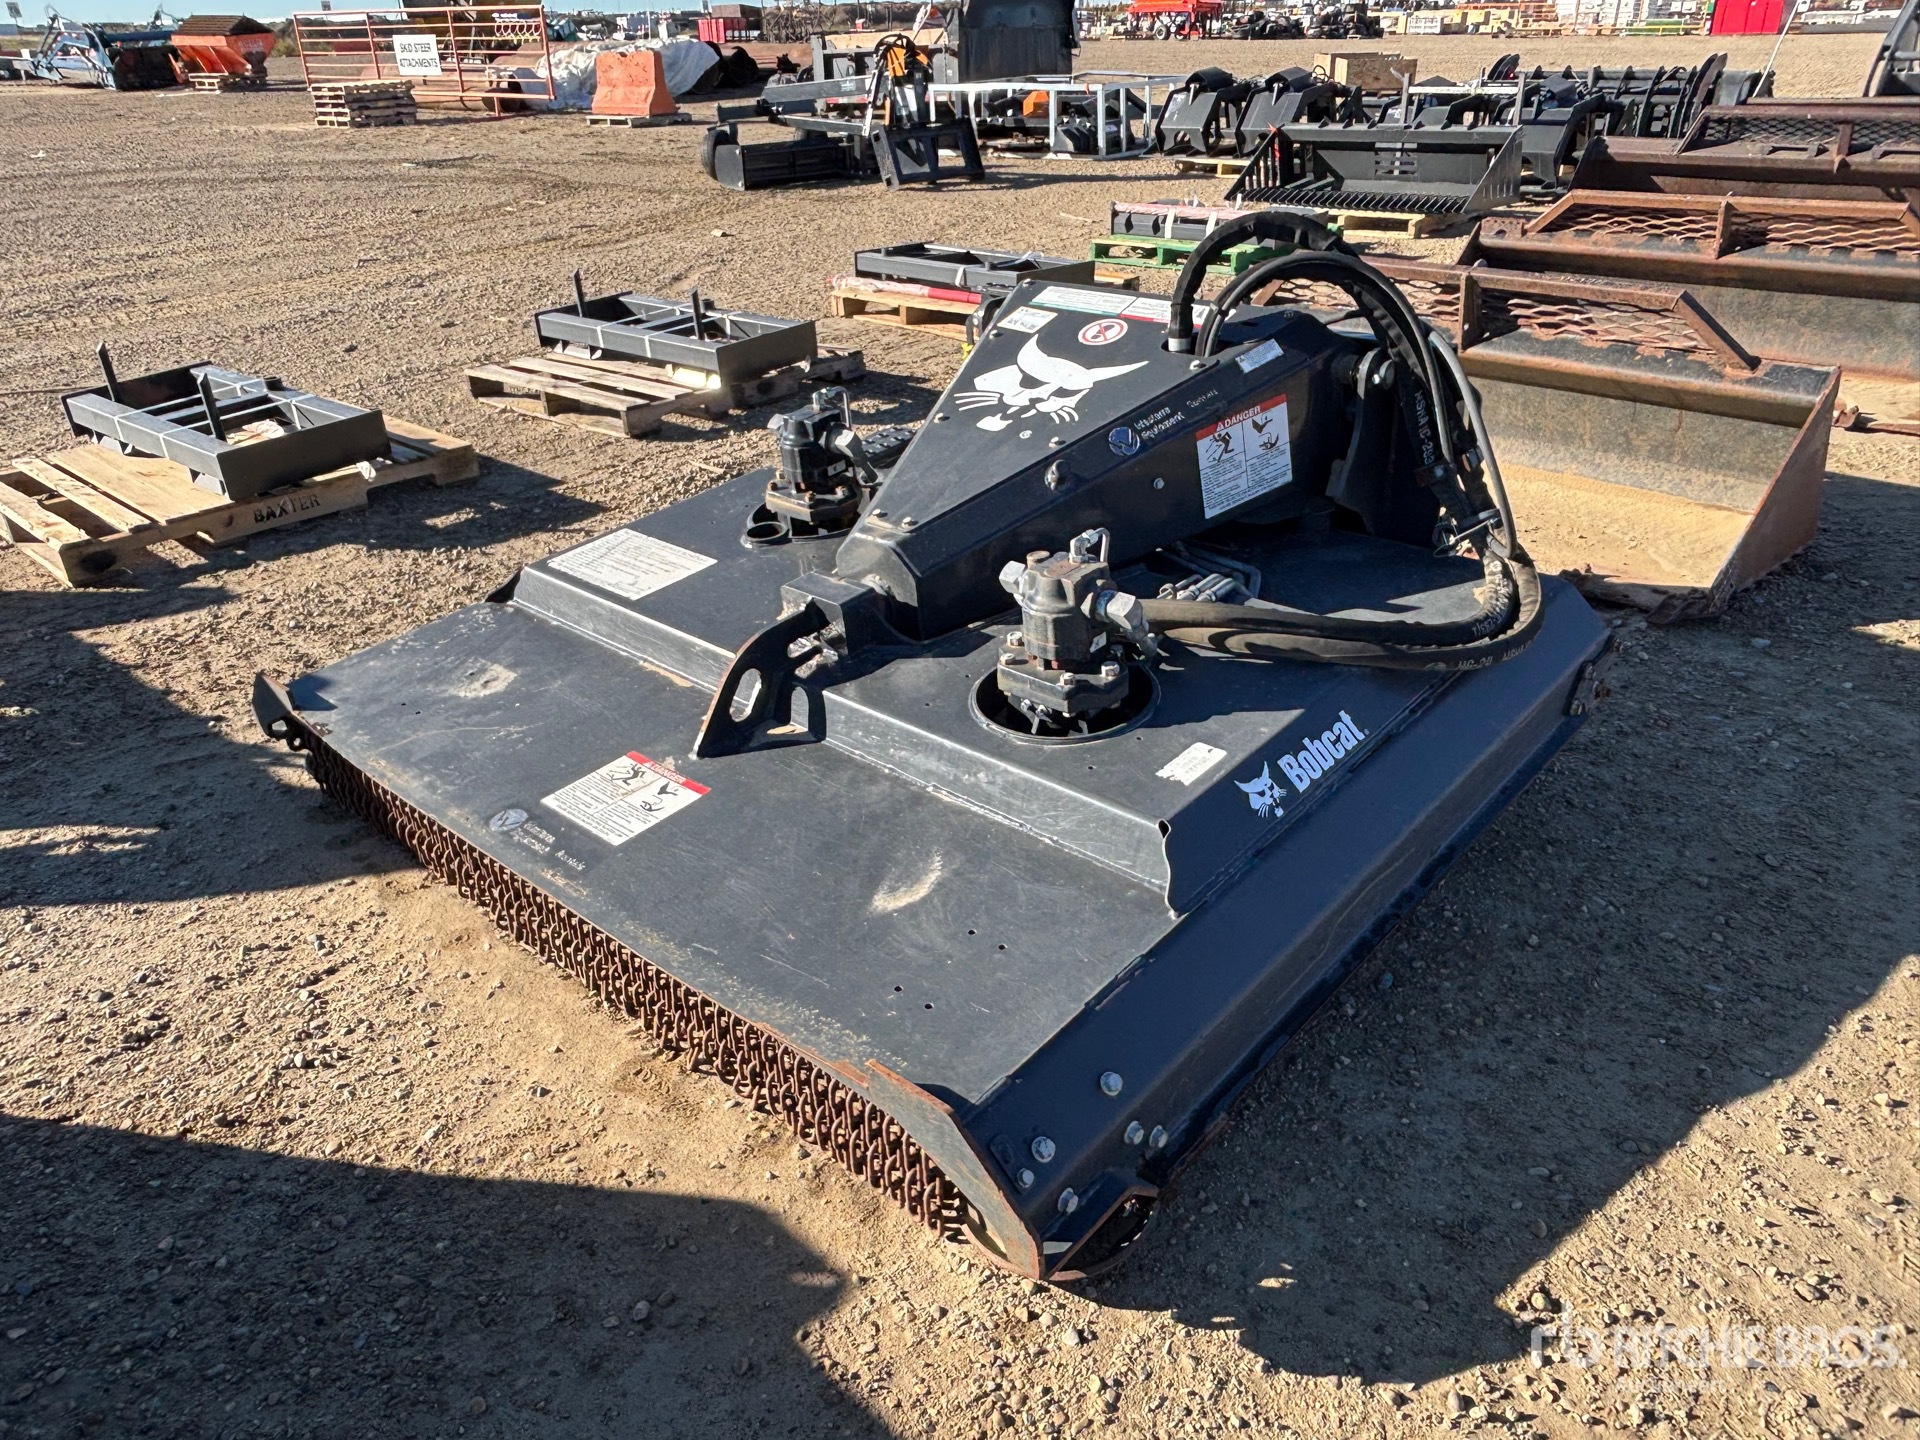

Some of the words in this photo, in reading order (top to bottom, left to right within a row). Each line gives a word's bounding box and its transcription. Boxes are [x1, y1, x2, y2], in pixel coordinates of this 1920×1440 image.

[400, 43, 413, 53] SKID
[413, 43, 431, 53] STEER
[400, 58, 438, 68] ATTACHMENTS
[1141, 411, 1186, 440] Equipment
[1224, 405, 1261, 428] DANGER
[253, 494, 321, 523] BAXTER
[1277, 709, 1366, 793] Bobcat
[653, 763, 687, 784] DANGER
